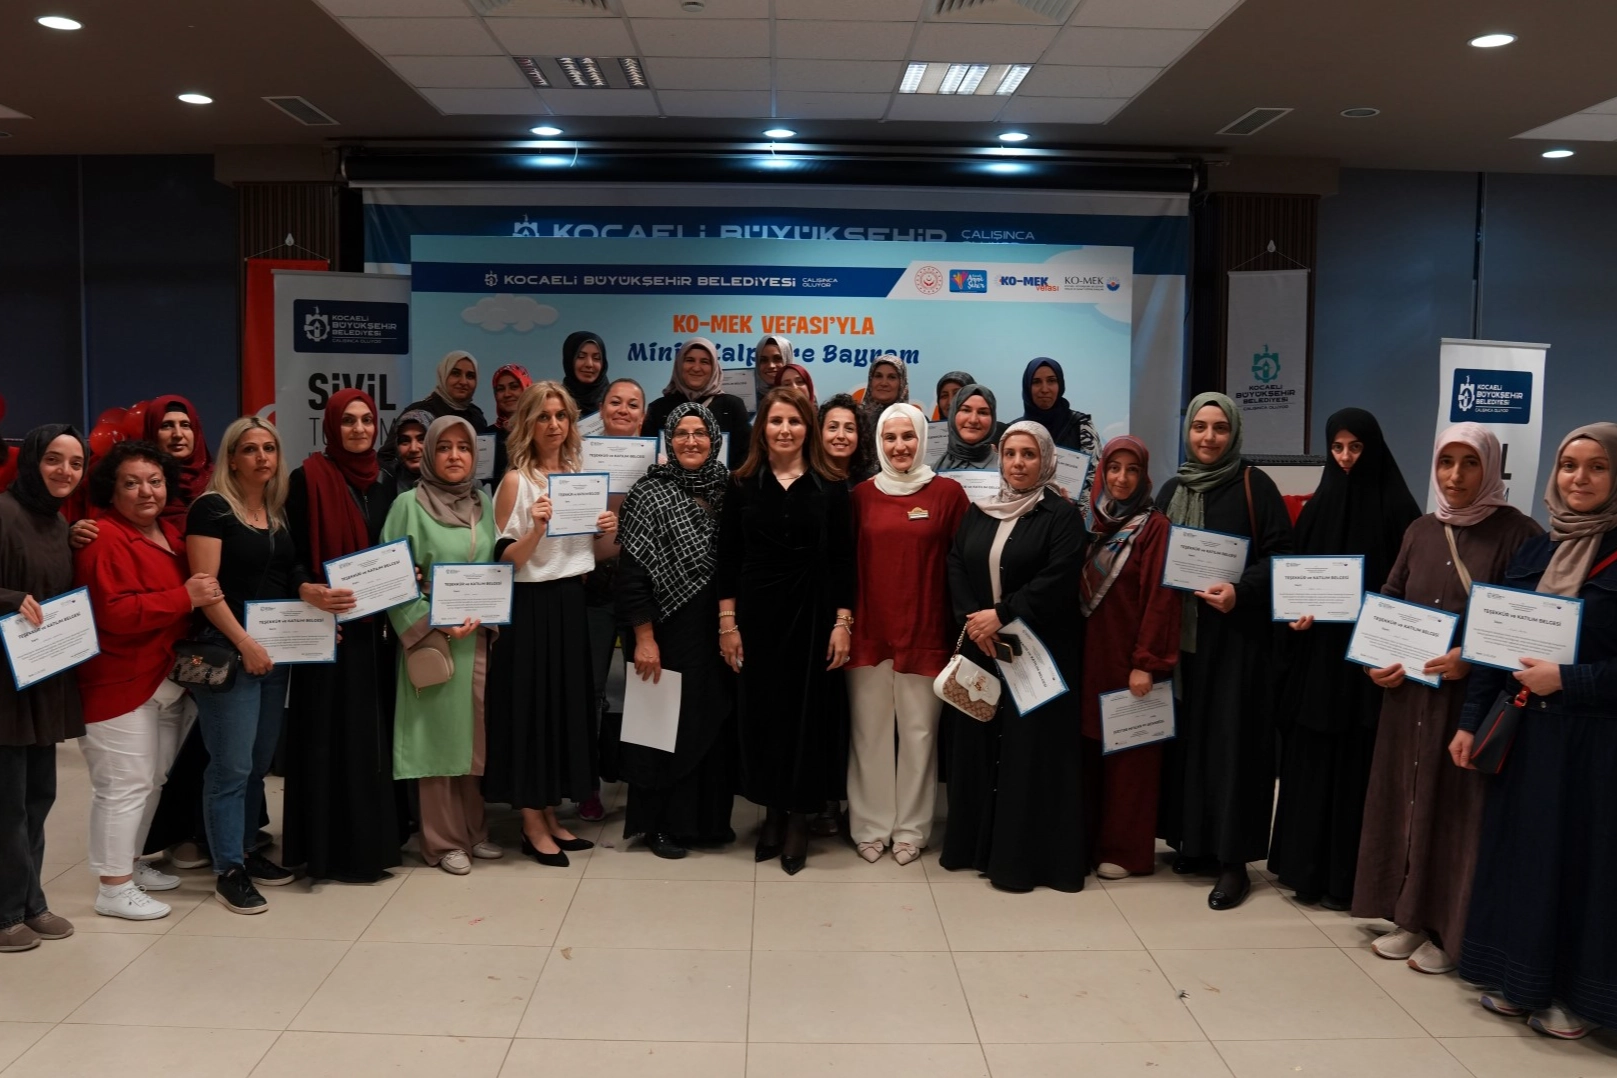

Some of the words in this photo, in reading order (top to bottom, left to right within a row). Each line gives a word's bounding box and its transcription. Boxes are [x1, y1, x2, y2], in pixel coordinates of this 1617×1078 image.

[961, 229, 1035, 241] ÇALIŞINCA
[1001, 276, 1049, 287] KO-MEK
[1064, 276, 1104, 285] KO-MEK
[672, 314, 753, 334] KO-MEK
[627, 342, 683, 361] Mini
